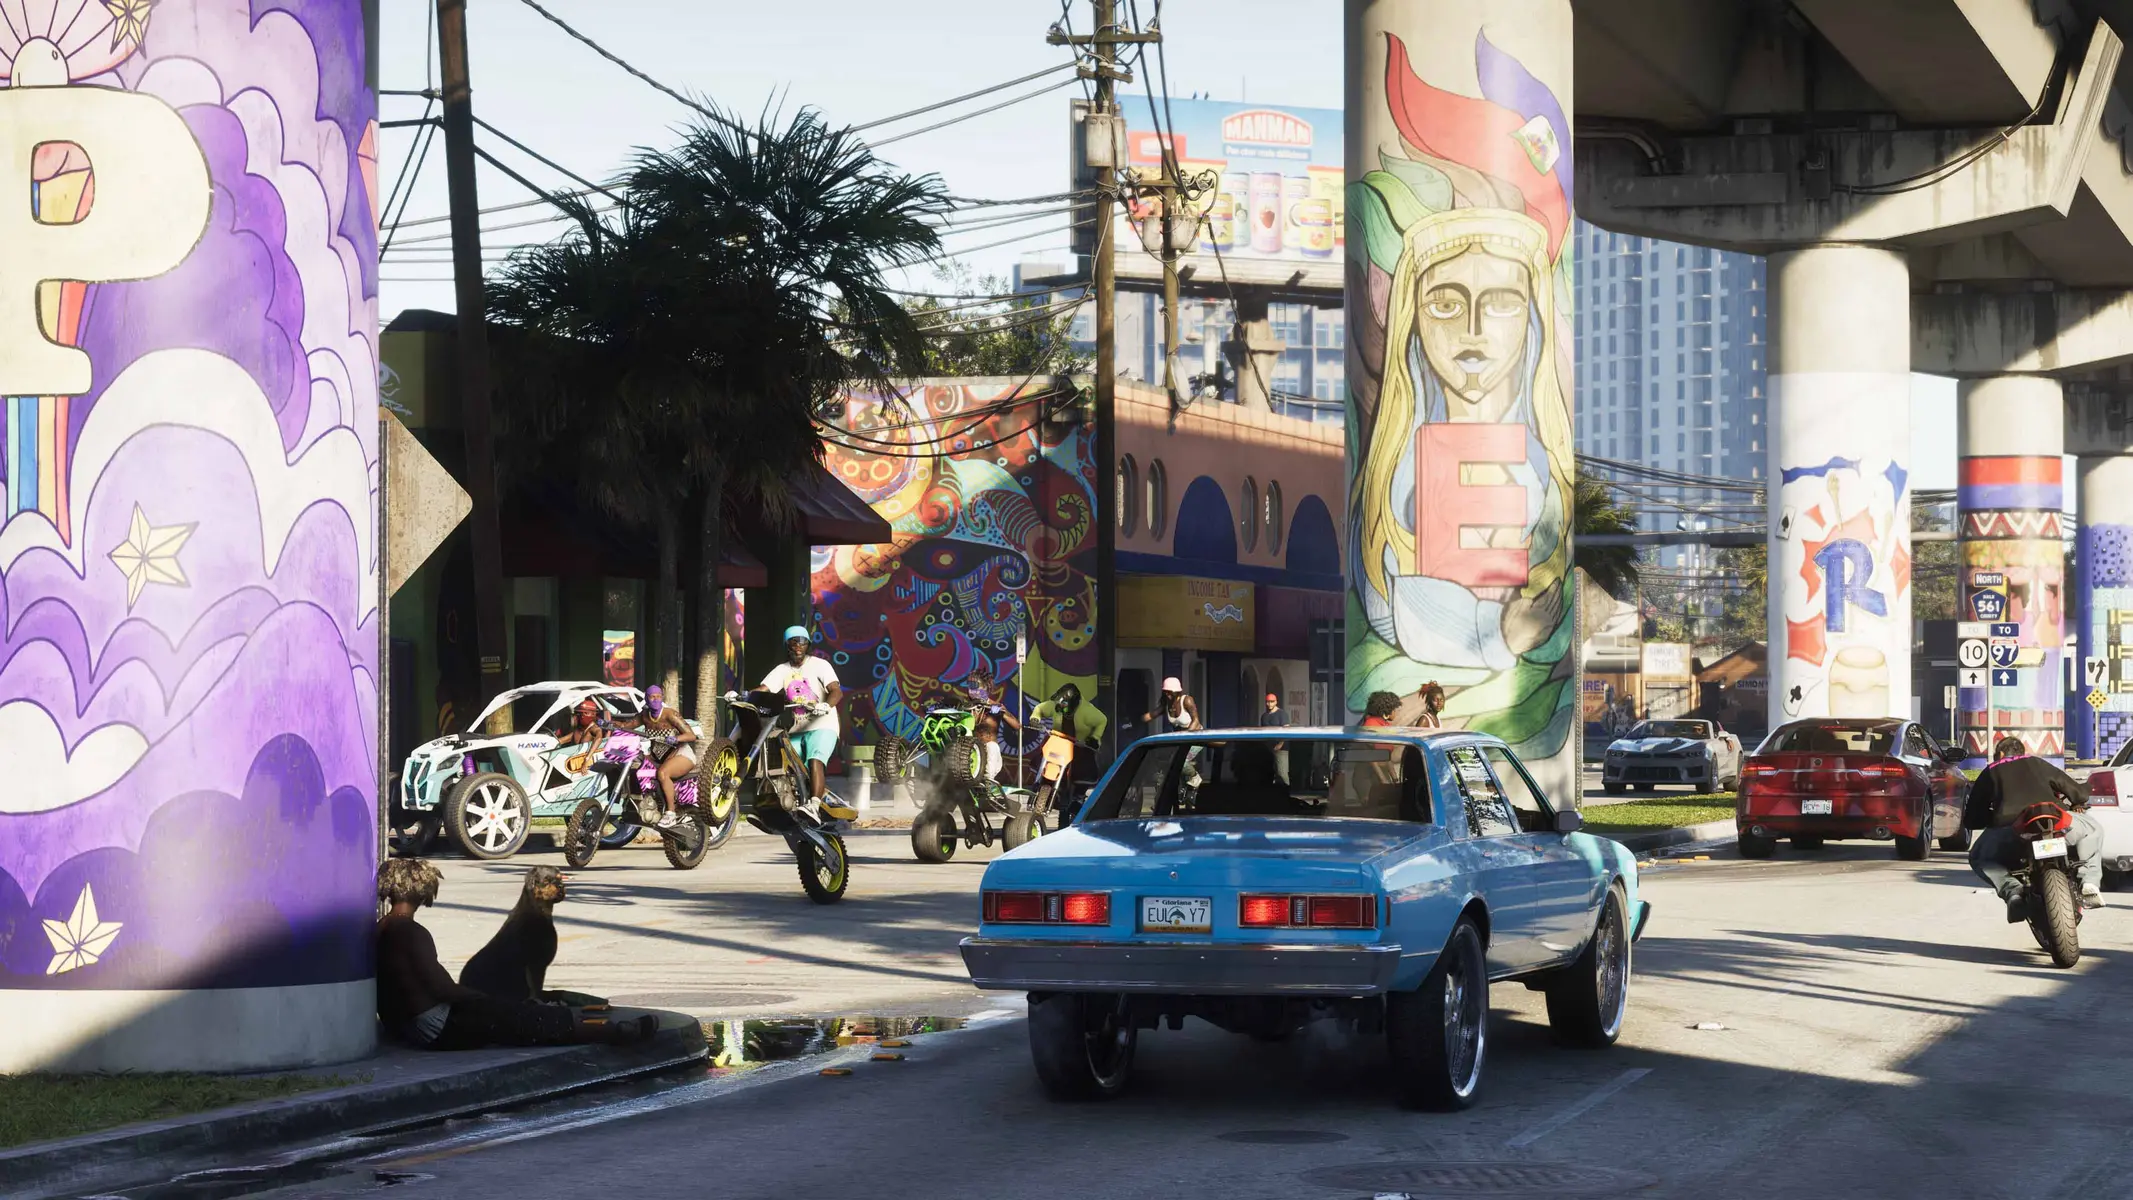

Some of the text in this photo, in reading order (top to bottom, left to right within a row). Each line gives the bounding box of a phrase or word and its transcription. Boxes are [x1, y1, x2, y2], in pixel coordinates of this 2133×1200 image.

[1225, 114, 1310, 144] MANMAN
[1416, 423, 1528, 587] E
[1813, 537, 1887, 633] R
[1976, 574, 2002, 584] NORTH
[1977, 600, 2000, 613] 561
[1999, 626, 2012, 634] TO
[1966, 645, 1983, 660] 10
[1992, 645, 2018, 662] 97
[517, 741, 548, 749] HAWX
[1189, 907, 1206, 923] Y7
